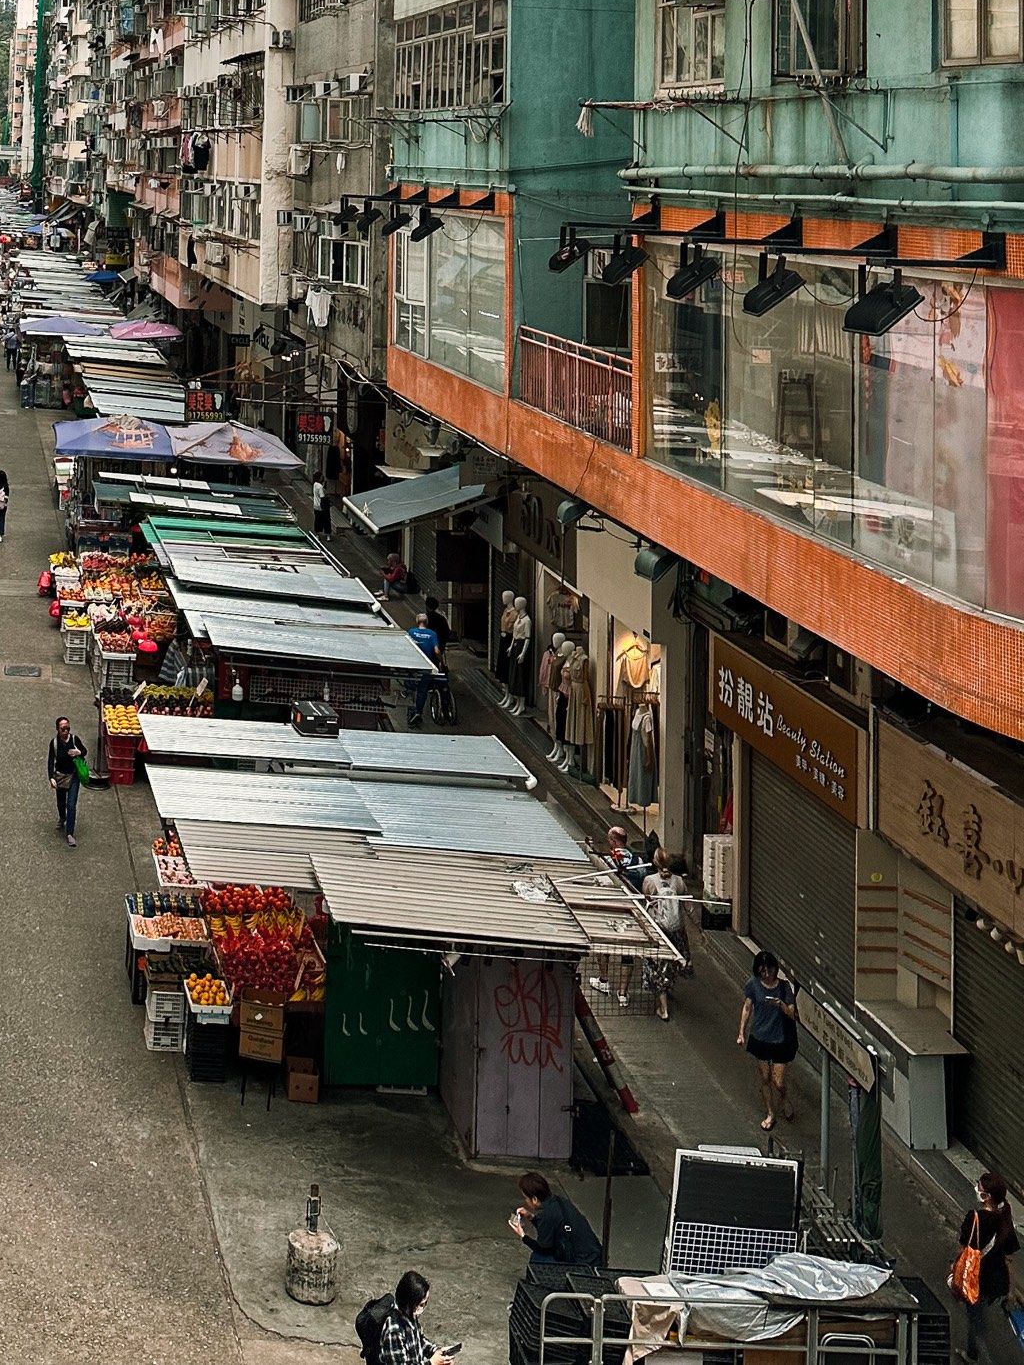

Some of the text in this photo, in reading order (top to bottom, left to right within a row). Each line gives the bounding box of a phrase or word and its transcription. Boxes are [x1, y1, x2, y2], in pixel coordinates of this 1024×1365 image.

[298, 433, 331, 444] 91755993
[718, 666, 774, 737] 扮靚站
[776, 714, 845, 778] Beauty Station
